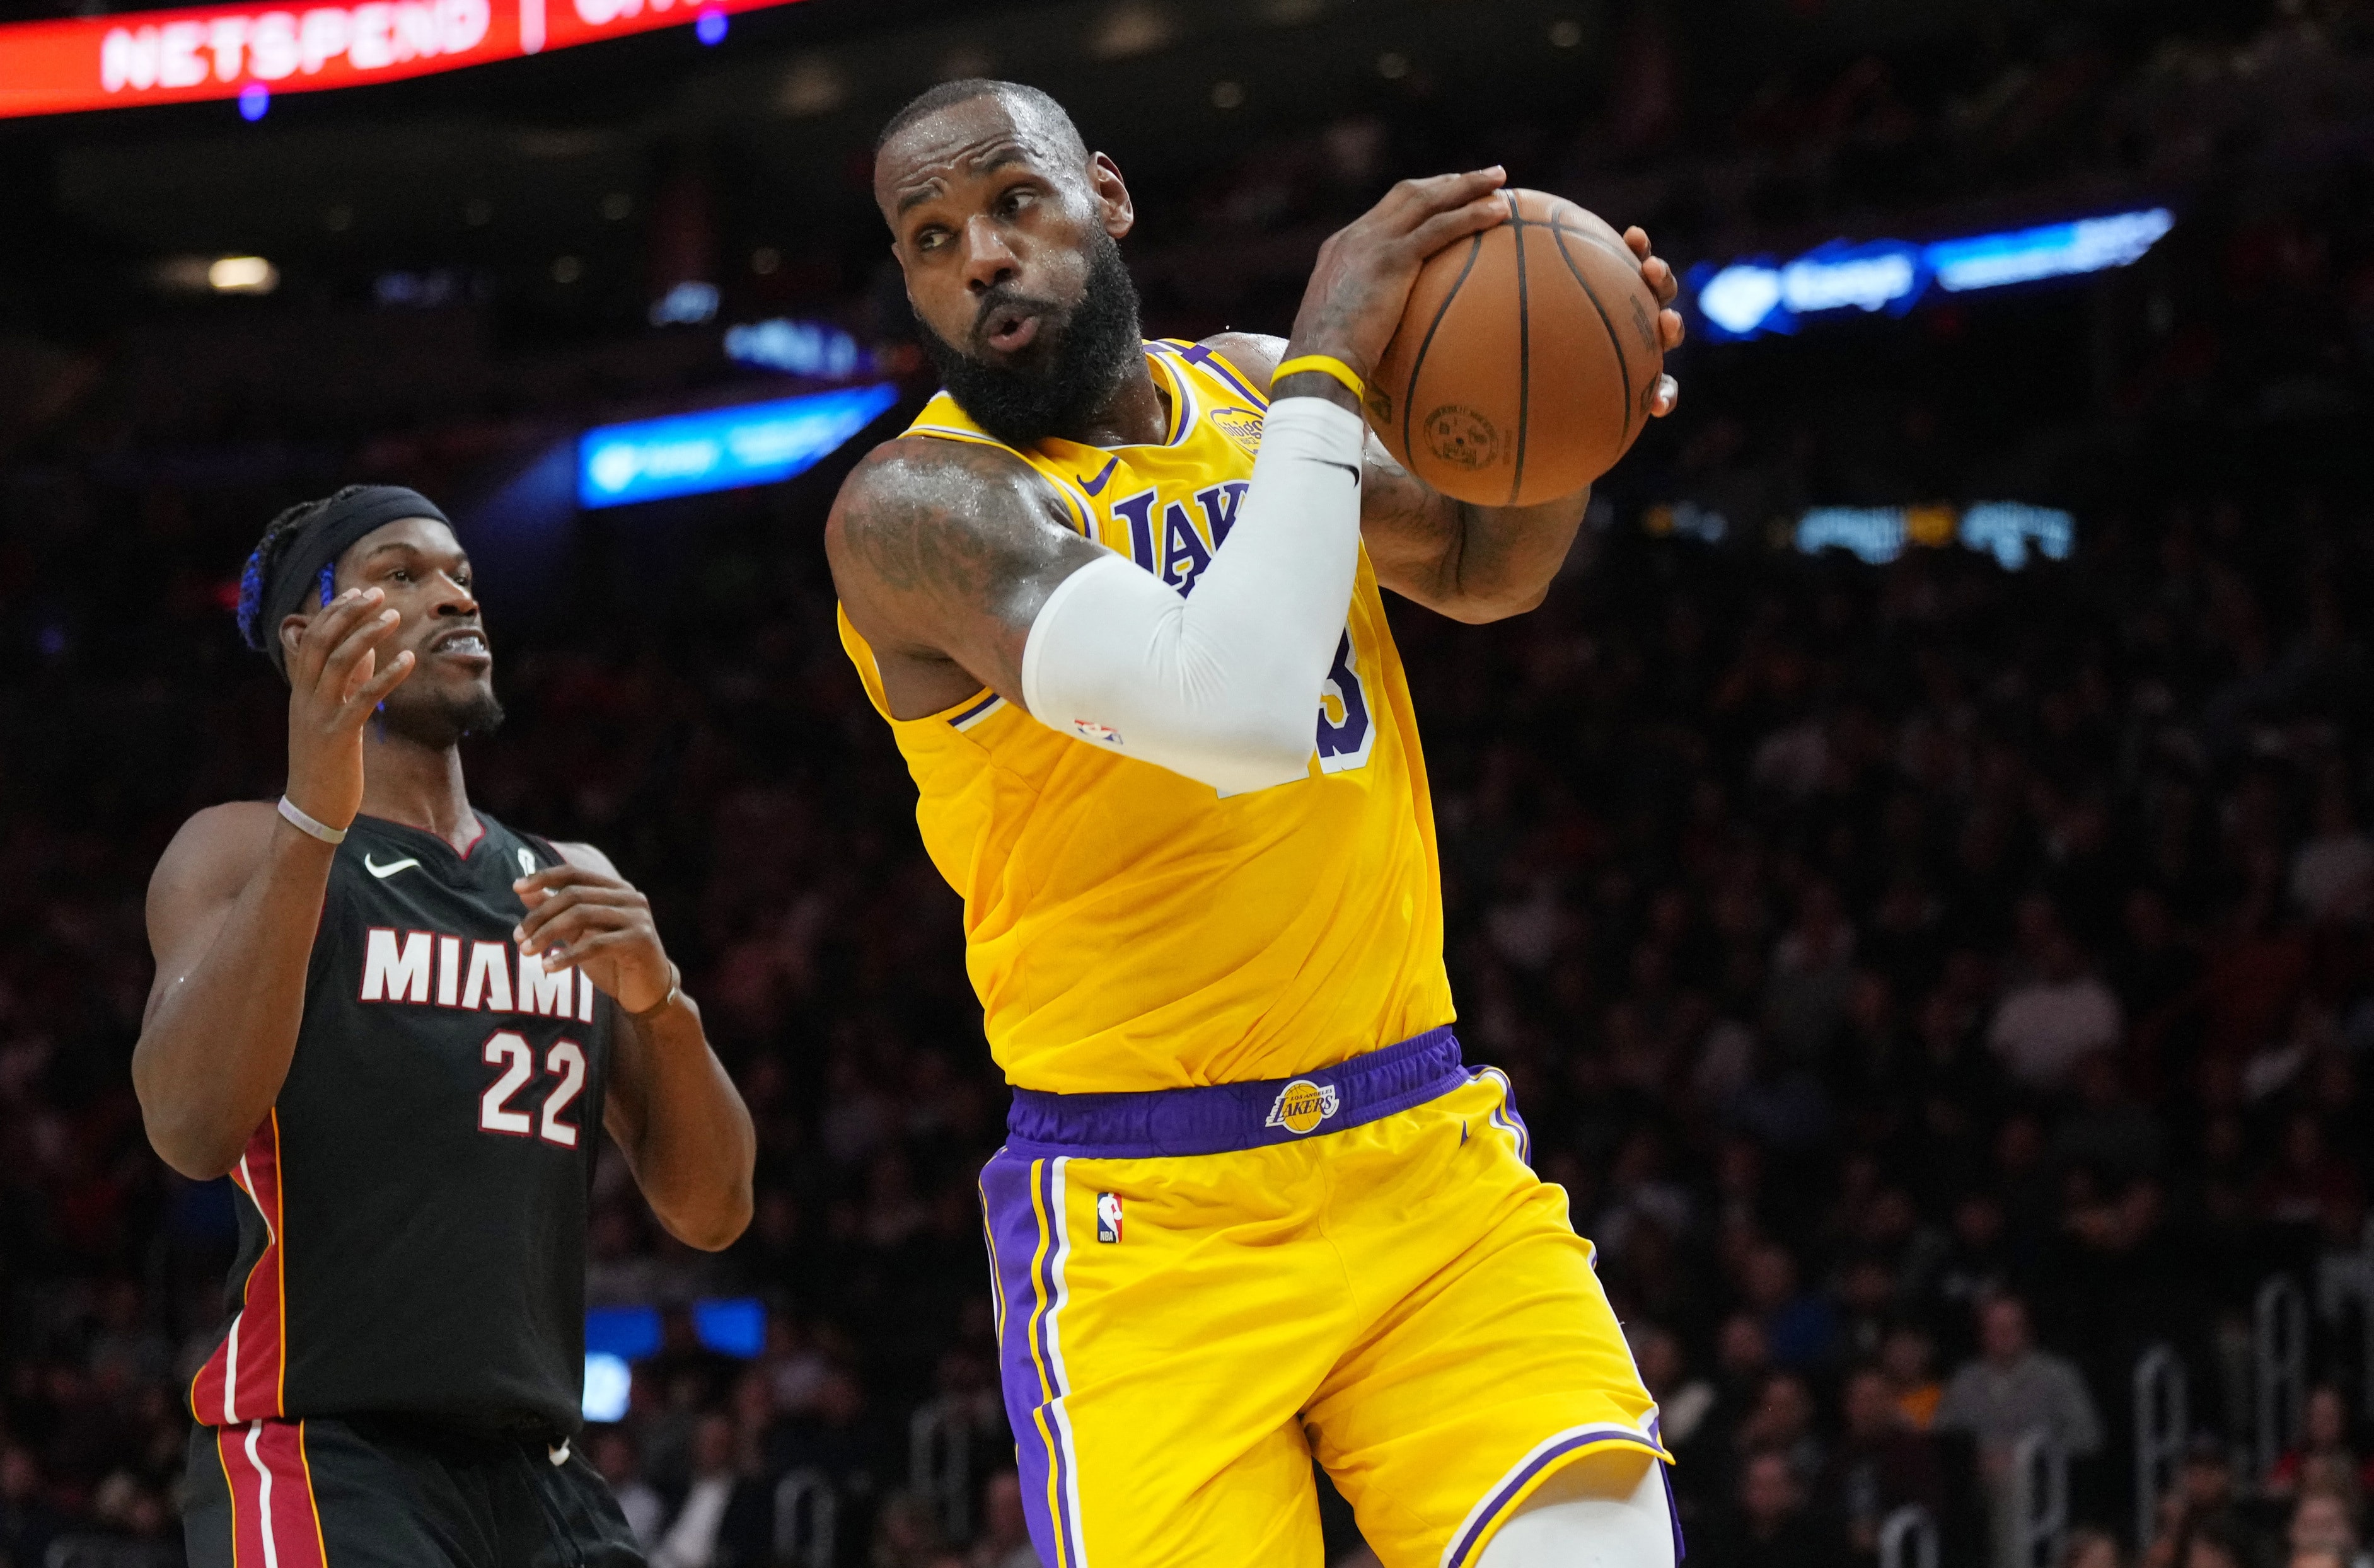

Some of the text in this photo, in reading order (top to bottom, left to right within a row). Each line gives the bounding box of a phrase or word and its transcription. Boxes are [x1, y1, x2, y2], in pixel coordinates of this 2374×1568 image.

[101, 0, 492, 92] NETSPEND
[358, 926, 594, 1023] MIAMI
[478, 1029, 588, 1150] 22
[1270, 1095, 1335, 1123] LAKERS
[1304, 1088, 1333, 1099] ANGELES
[1101, 1231, 1113, 1241] NBA
